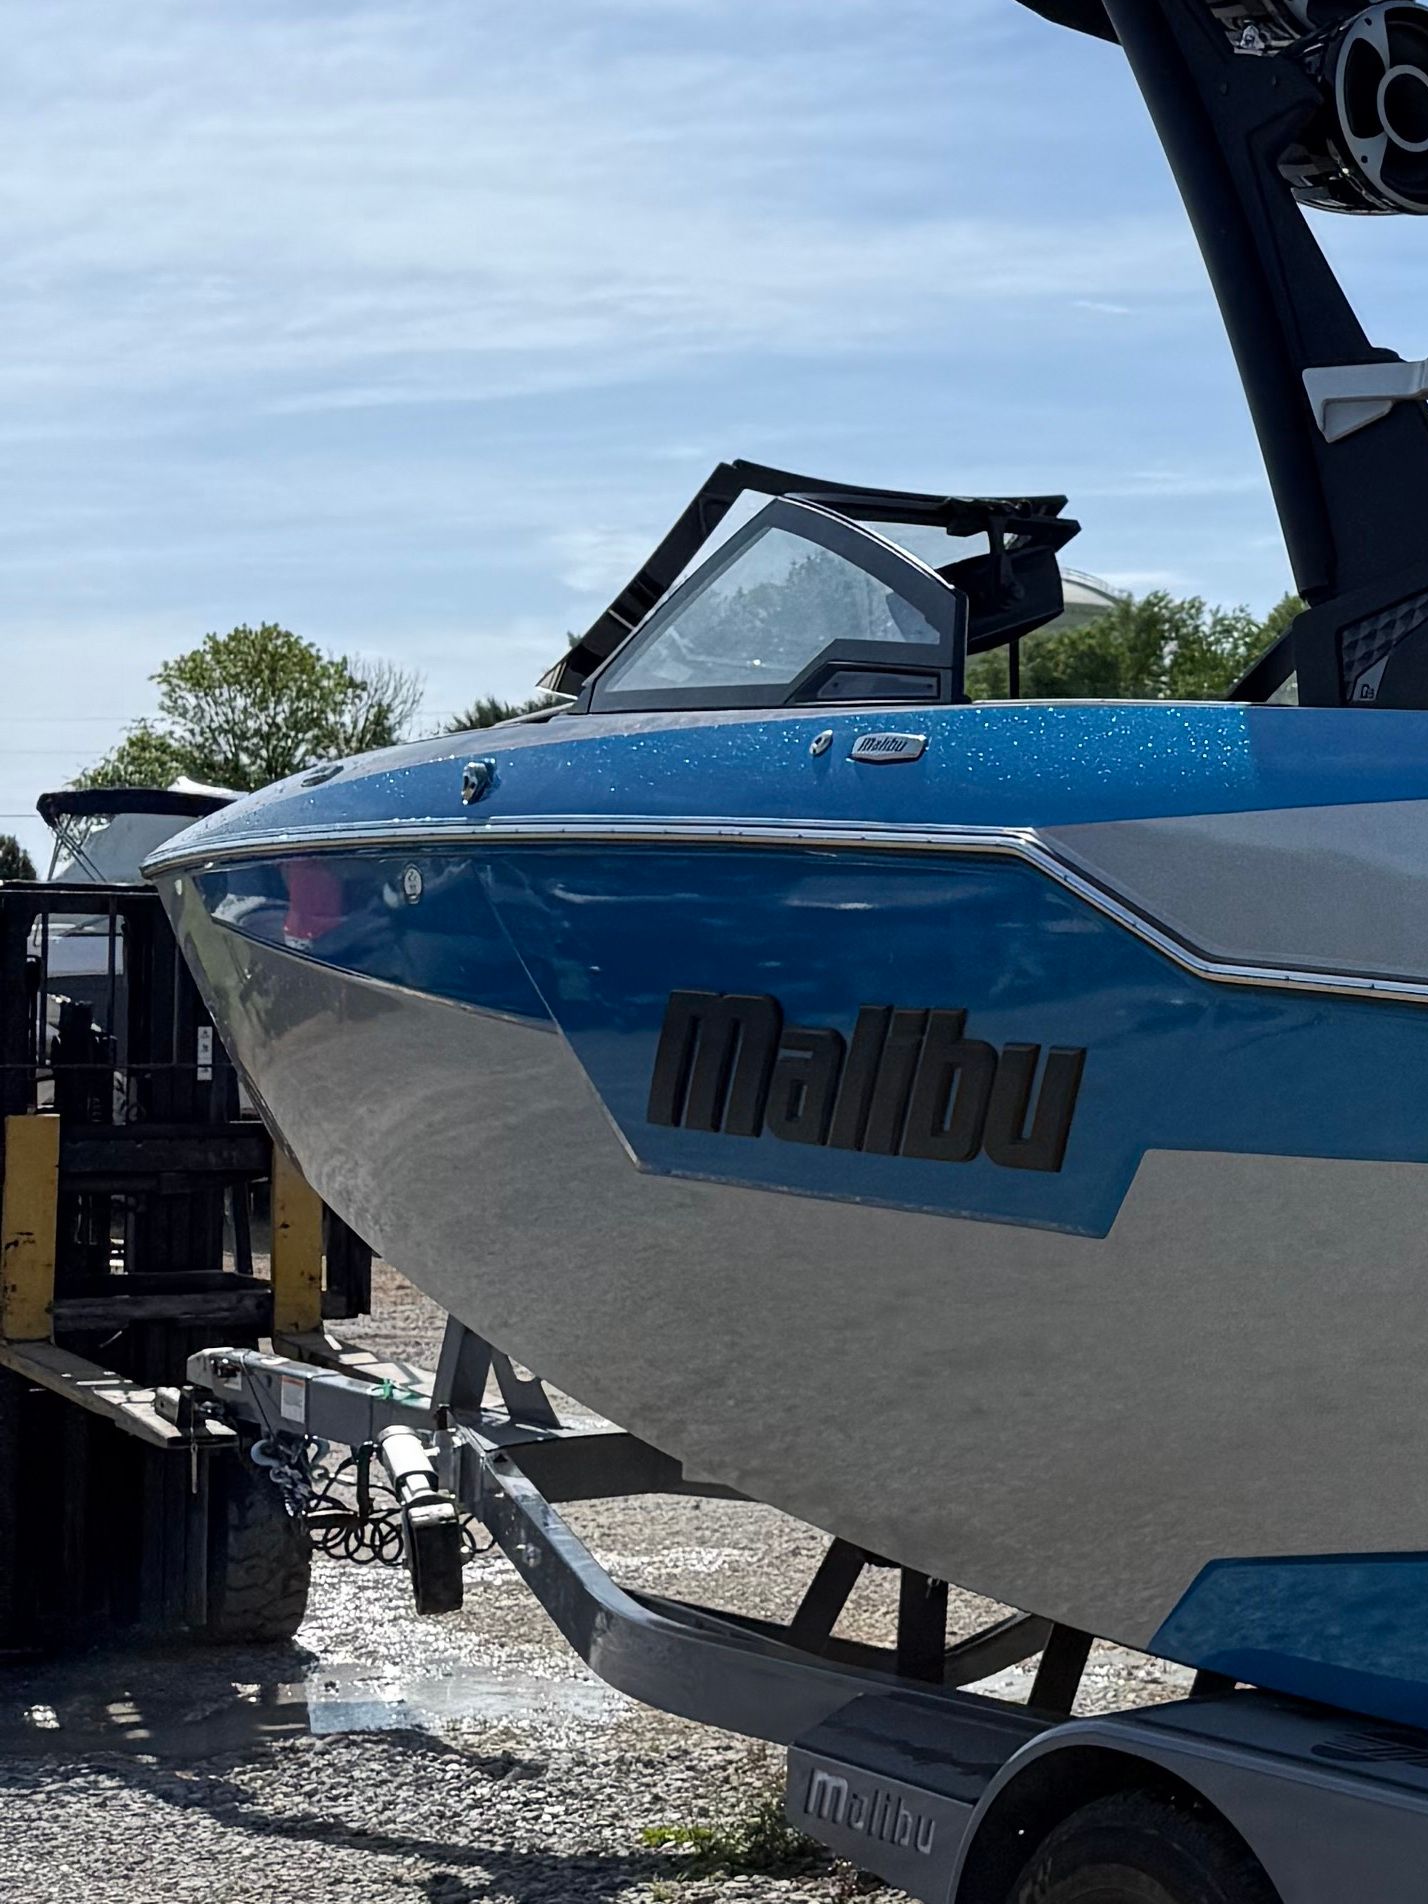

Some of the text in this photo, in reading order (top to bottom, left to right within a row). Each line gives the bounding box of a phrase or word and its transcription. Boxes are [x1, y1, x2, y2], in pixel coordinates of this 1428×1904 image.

[857, 736, 908, 752] Malibu
[646, 988, 1088, 1173] Malibu
[804, 1767, 936, 1856] Malibu
